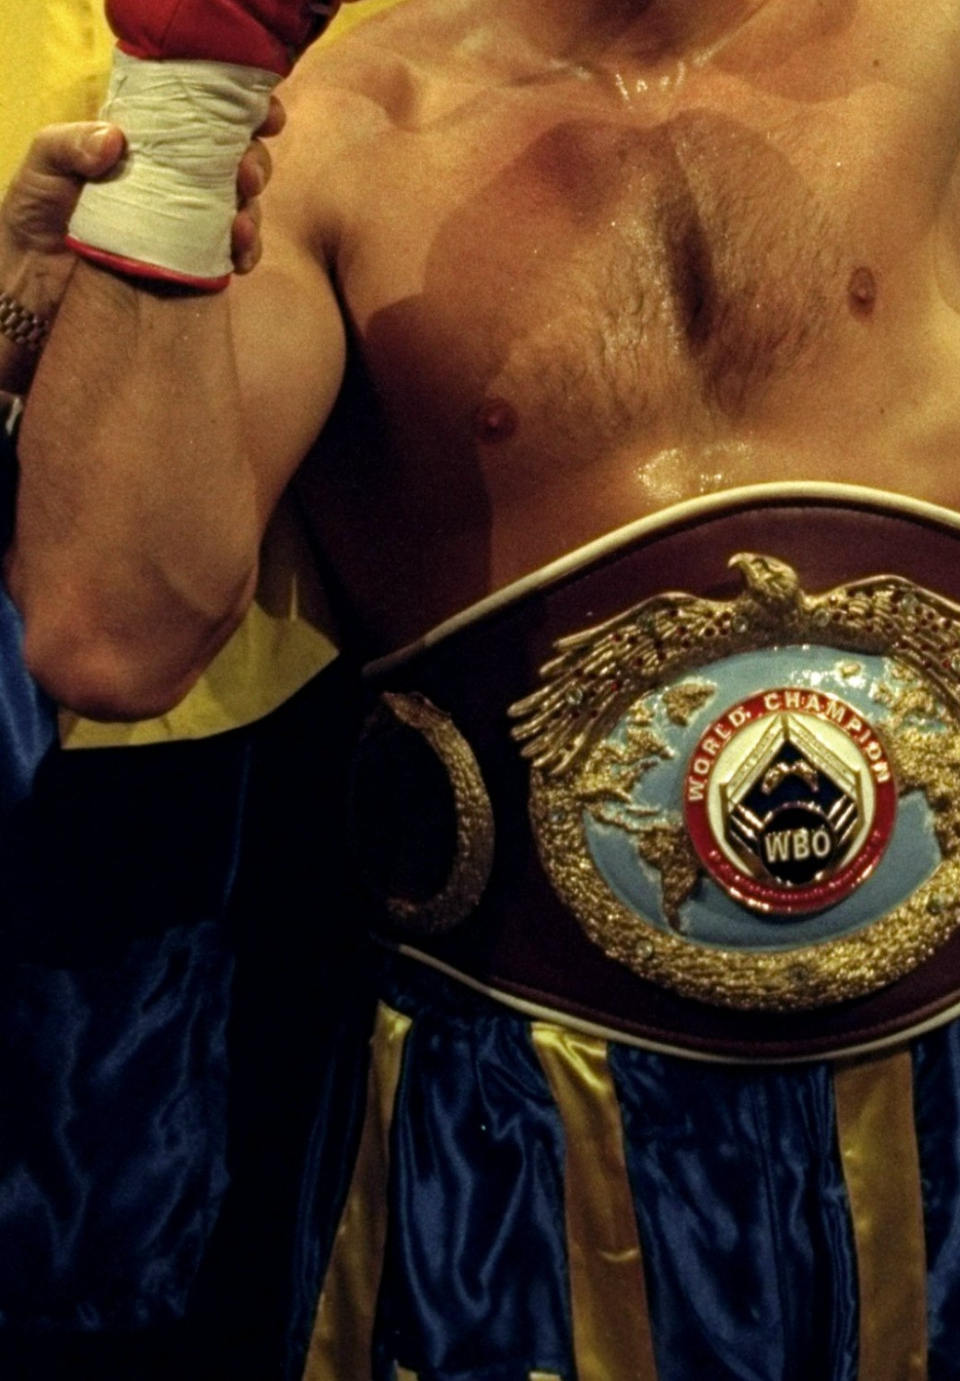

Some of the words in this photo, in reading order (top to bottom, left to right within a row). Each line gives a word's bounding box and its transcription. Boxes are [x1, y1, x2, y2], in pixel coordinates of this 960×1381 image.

[689, 706, 749, 802] WORLD
[763, 691, 892, 784] CHAMPION
[764, 828, 831, 863] WBO
